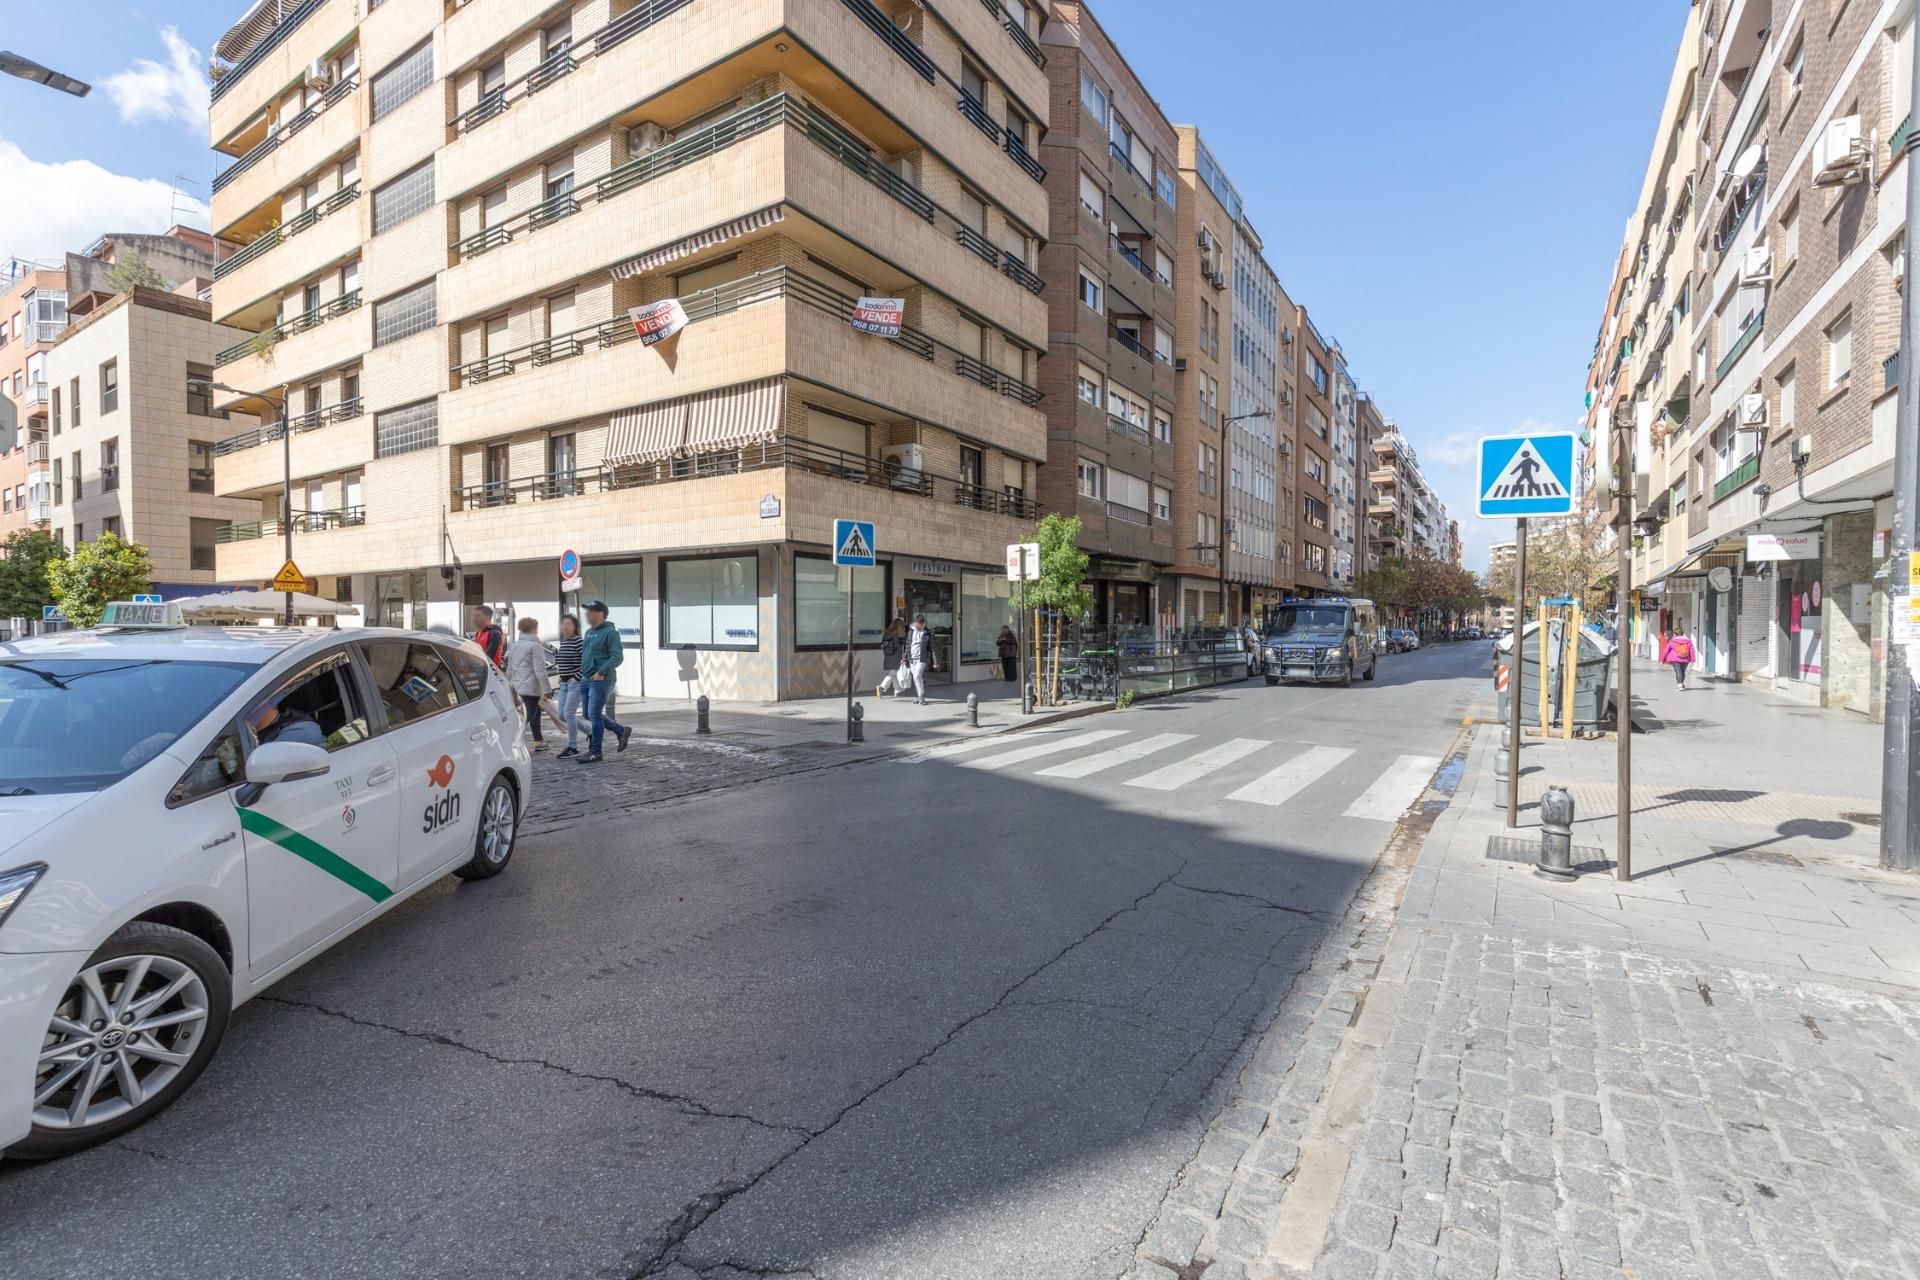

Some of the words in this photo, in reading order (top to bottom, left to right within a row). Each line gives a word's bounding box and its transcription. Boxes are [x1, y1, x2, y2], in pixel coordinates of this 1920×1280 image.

[639, 312, 672, 332] VEND
[861, 310, 897, 323] VENDE
[852, 319, 868, 329] 958
[868, 323, 879, 332] 07
[889, 326, 898, 335] 79
[642, 333, 659, 345] 958
[1785, 537, 1808, 545] salud
[119, 605, 151, 622] TAXI
[335, 776, 353, 791] TAXI
[423, 789, 460, 834] sidn
